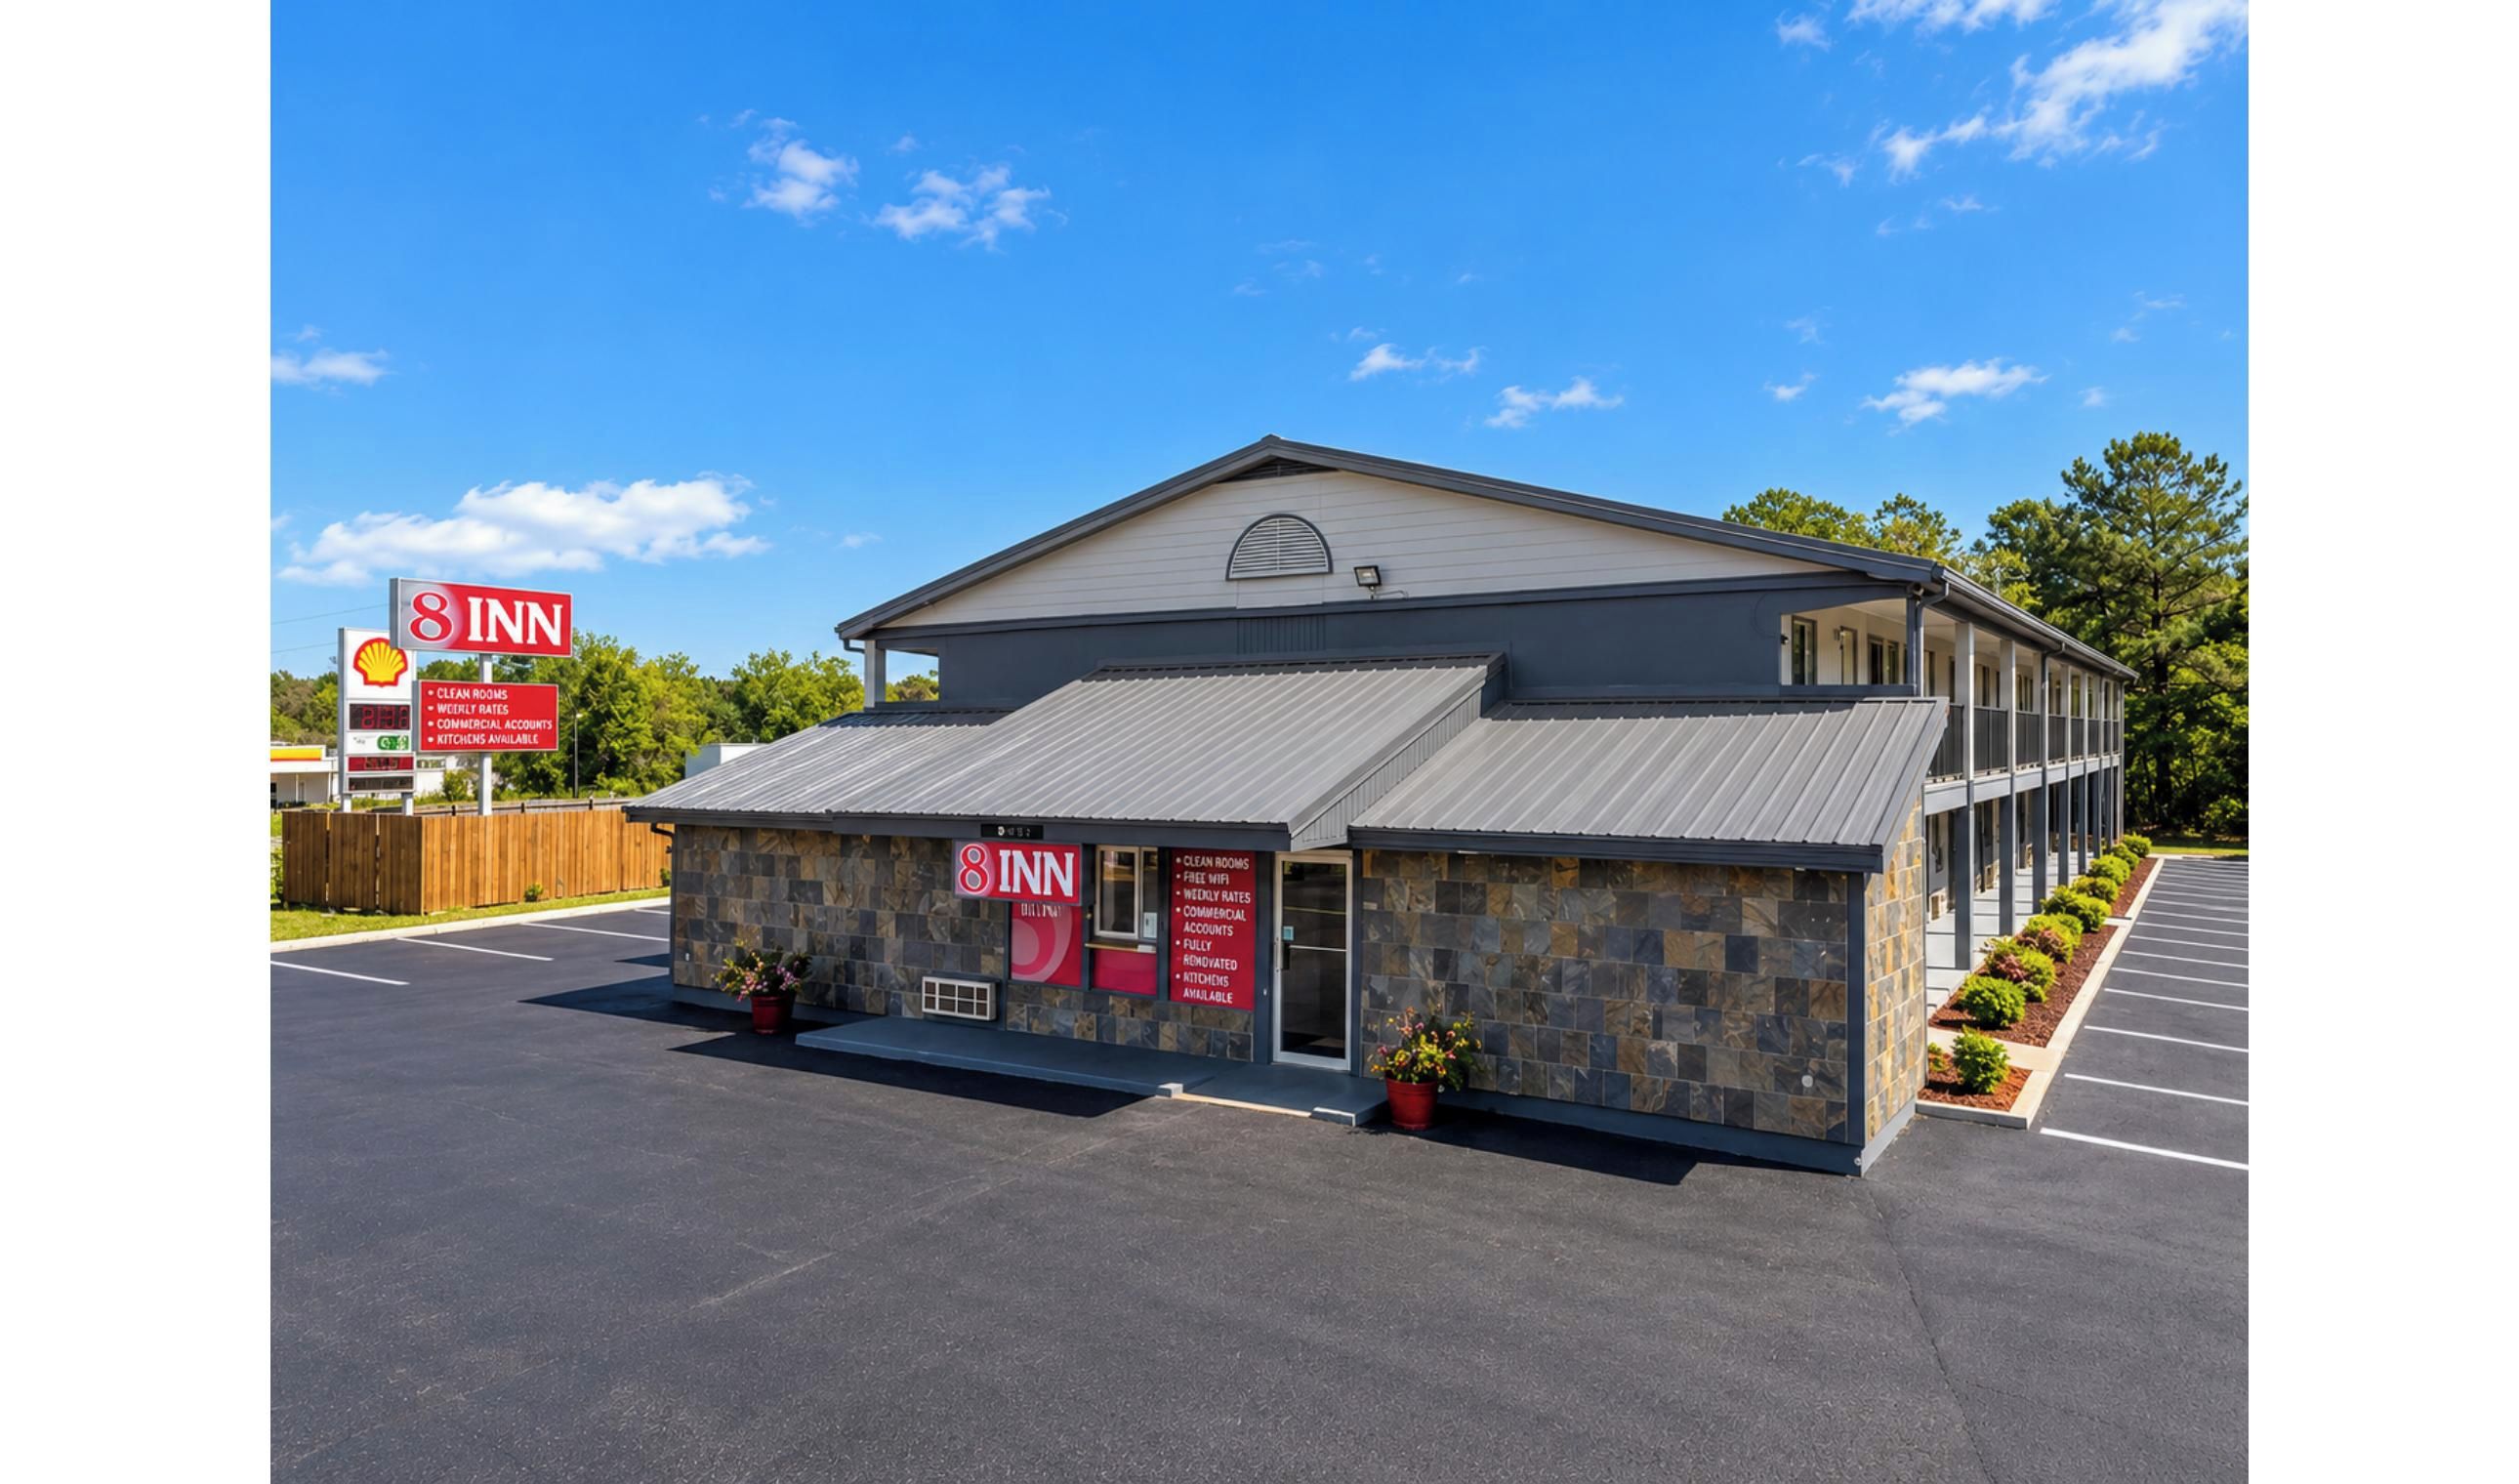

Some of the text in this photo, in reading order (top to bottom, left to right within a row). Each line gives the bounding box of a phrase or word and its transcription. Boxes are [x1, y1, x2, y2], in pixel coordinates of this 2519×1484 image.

[408, 591, 563, 646] 8 INN
[473, 688, 509, 701] ROOMS
[478, 704, 509, 716] RATES
[436, 718, 554, 731] COMMERCIAL ACCOUNTS
[436, 733, 539, 745] KITCHENS AVAILABLE
[1183, 855, 1250, 870] CLEAN ROOMS
[958, 844, 1075, 897] 8 INN
[1183, 871, 1206, 885] FREE
[1183, 887, 1251, 904] WEEKLY RATES
[1183, 904, 1247, 922] COMMERCIAL
[1183, 921, 1234, 936] ACCOUNTS
[1183, 938, 1213, 952] FULLY
[1183, 954, 1238, 971] RENOVATED
[1183, 971, 1230, 988] KITCHENS
[1183, 987, 1234, 1005] AVAILABLE
